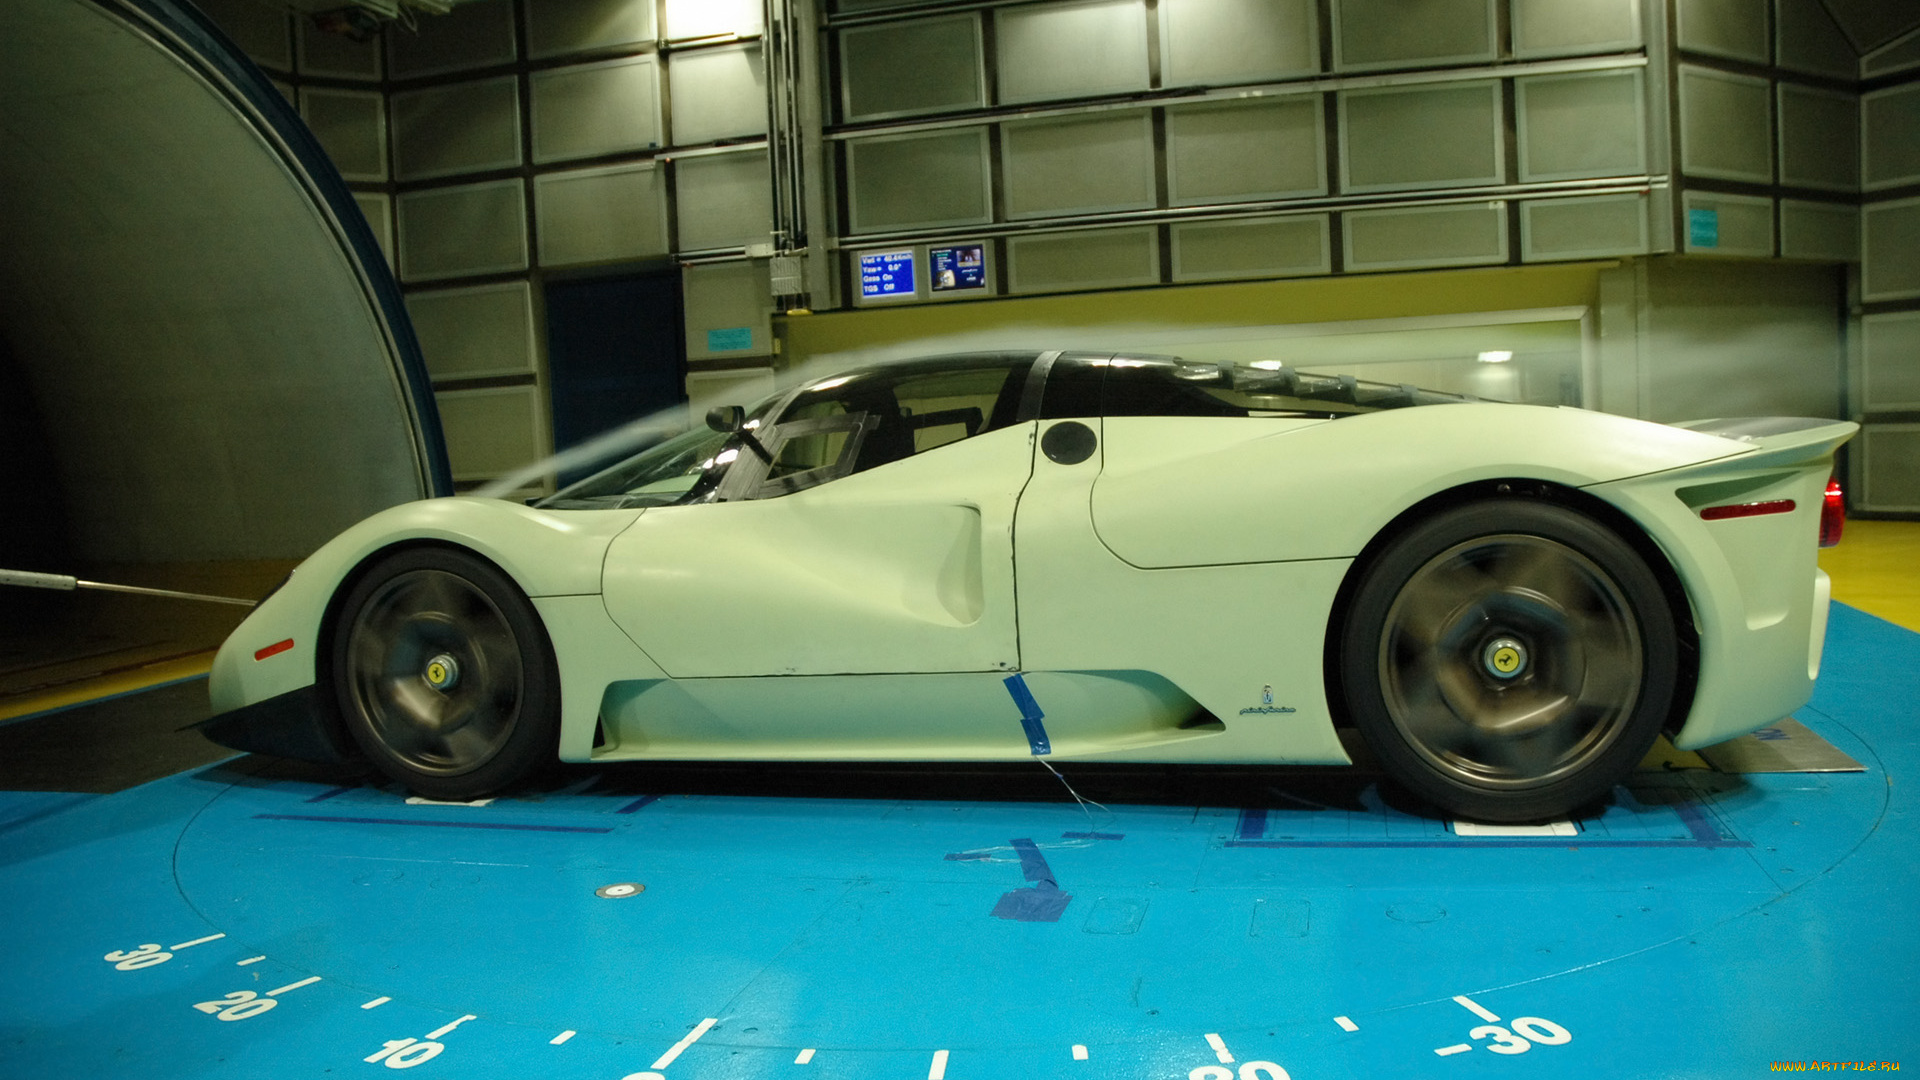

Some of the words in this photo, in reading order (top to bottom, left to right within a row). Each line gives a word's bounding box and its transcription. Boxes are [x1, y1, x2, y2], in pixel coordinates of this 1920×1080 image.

[882, 273, 893, 281] On
[884, 283, 895, 291] Off
[104, 943, 173, 971] 30
[192, 990, 278, 1021] 20
[1434, 1016, 1572, 1057] -30
[363, 1037, 445, 1069] 10
